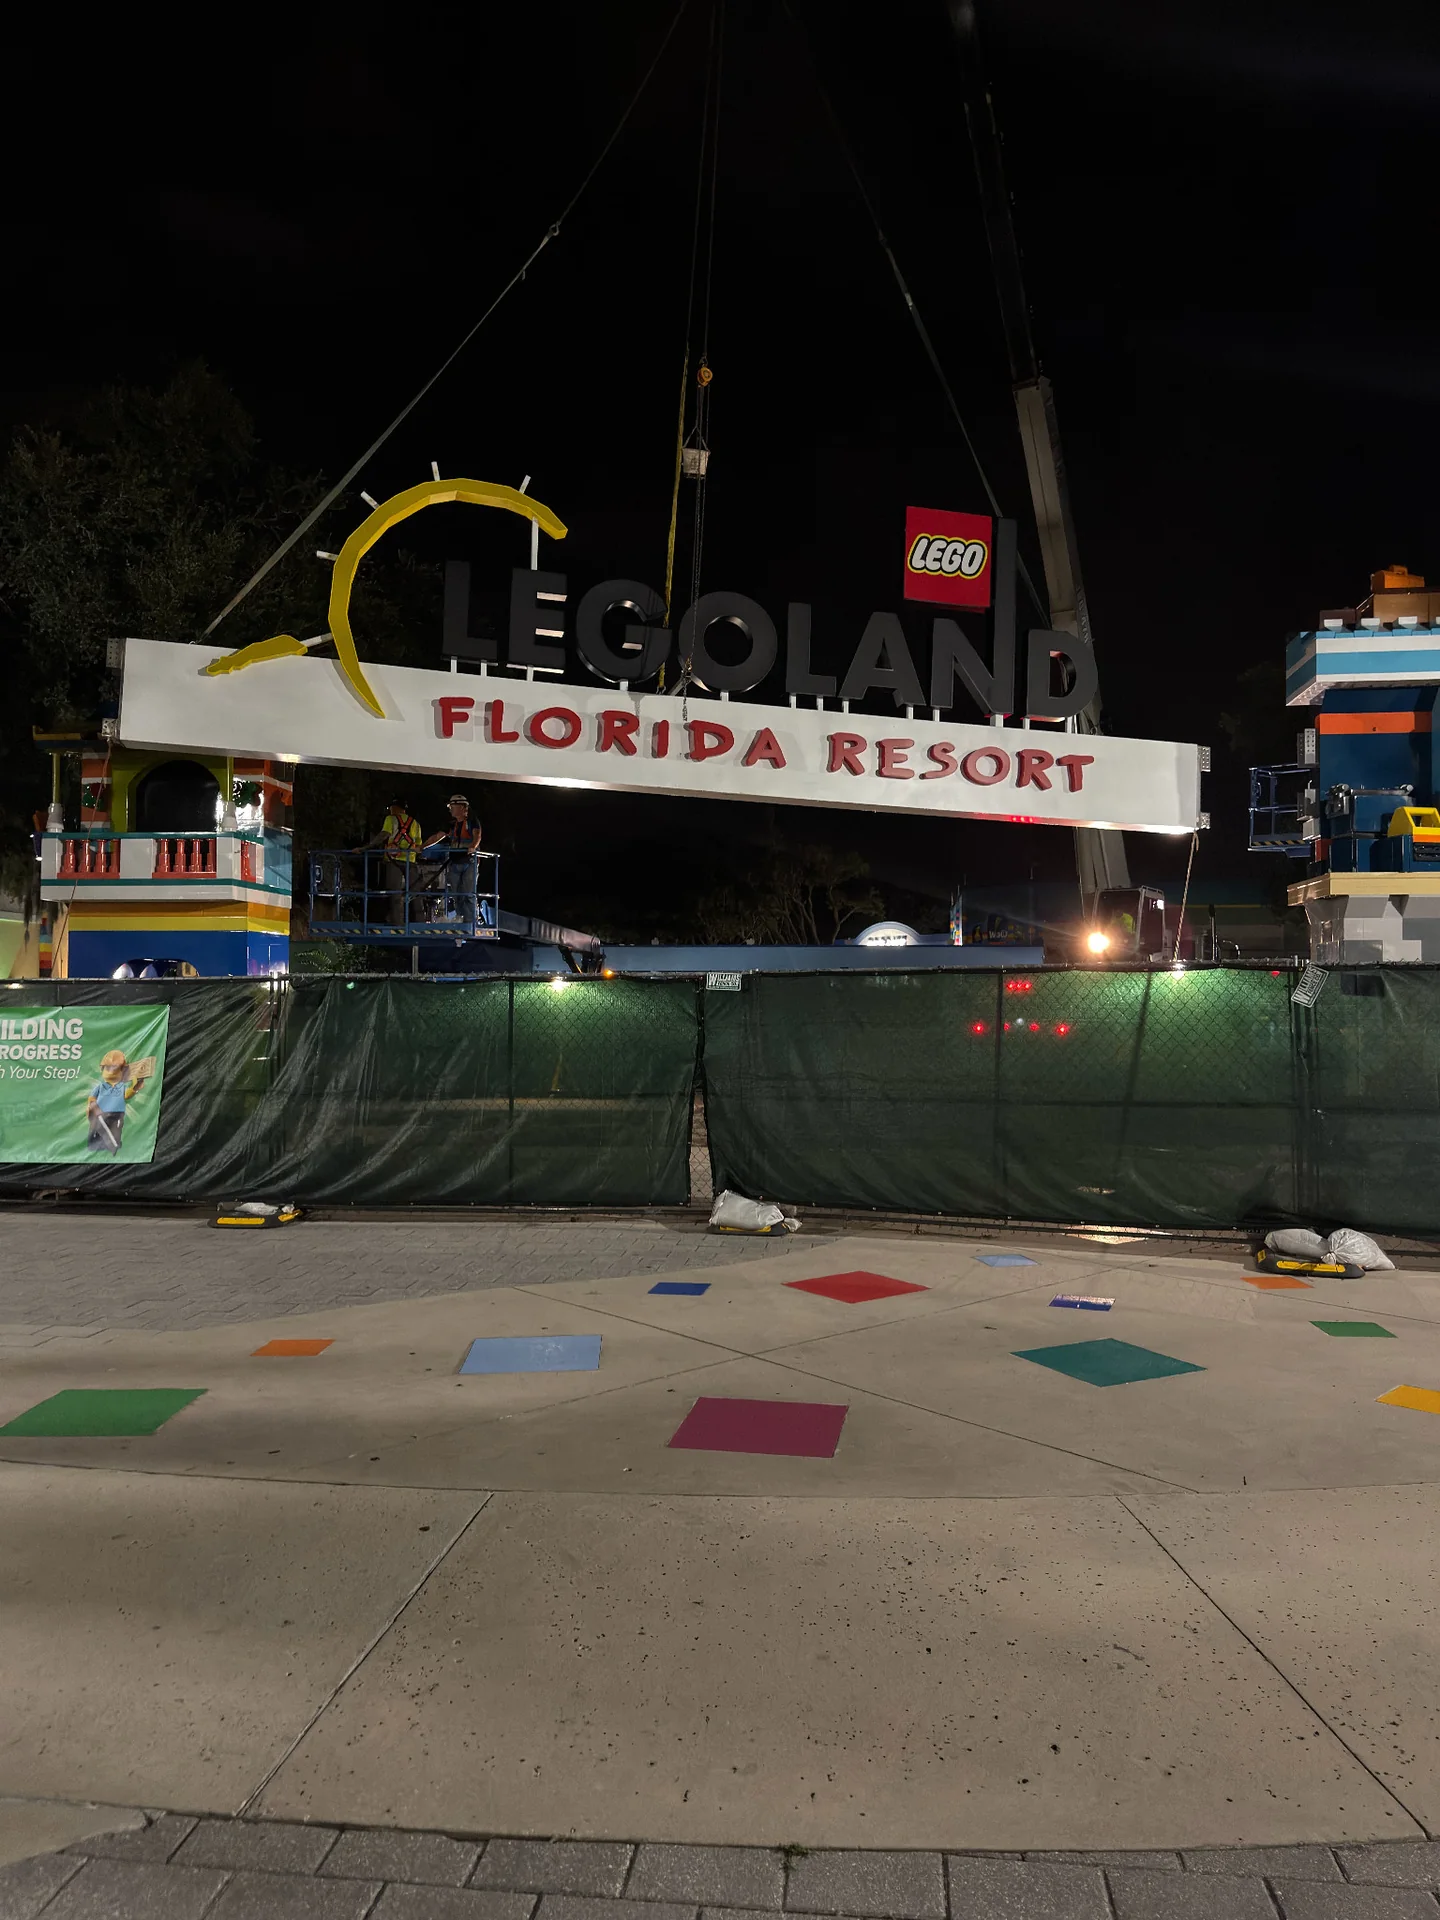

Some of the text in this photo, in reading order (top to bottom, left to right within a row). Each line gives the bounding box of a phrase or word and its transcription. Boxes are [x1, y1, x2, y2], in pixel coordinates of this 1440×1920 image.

[908, 533, 988, 579] LEGO
[443, 517, 1099, 720] LEGOLAND
[435, 696, 1095, 793] FLORIDA RESORT
[1293, 966, 1317, 1004] WILLIAMS
[9, 1065, 41, 1079] Your
[43, 1065, 81, 1082] Step!
